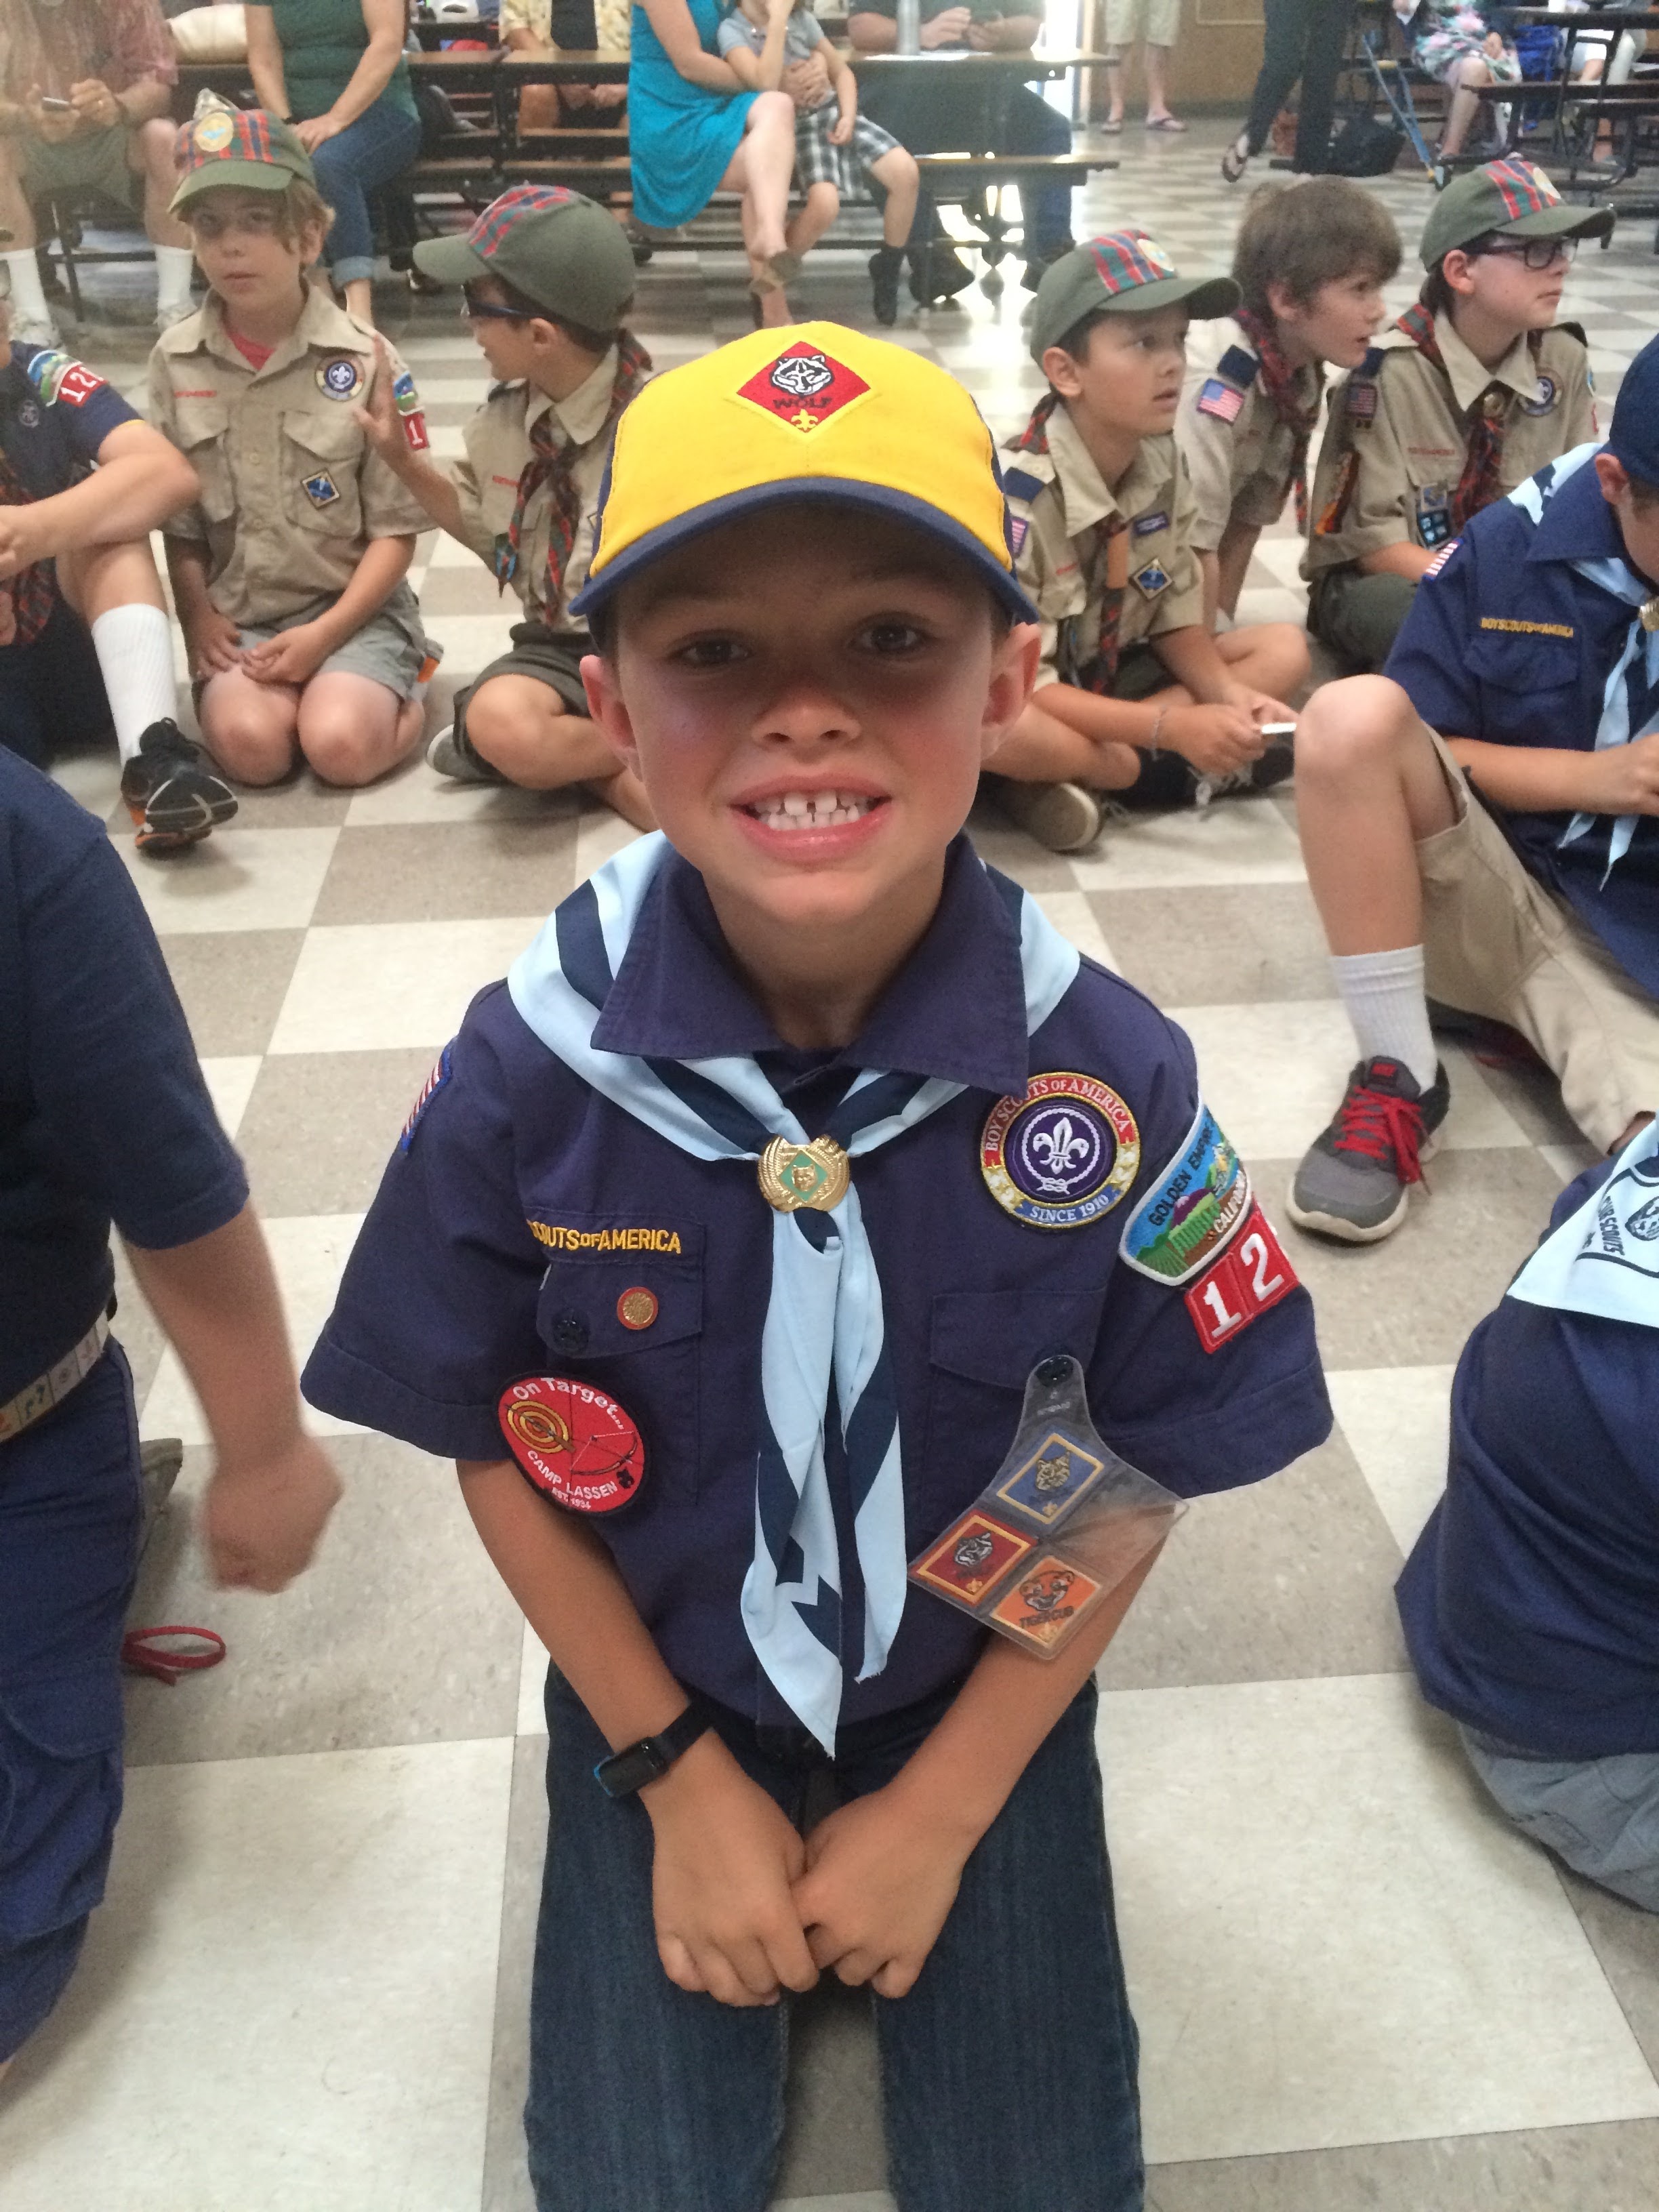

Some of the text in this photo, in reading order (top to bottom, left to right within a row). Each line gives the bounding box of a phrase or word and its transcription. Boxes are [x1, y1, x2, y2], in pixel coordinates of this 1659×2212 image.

[773, 397, 833, 409] WOLF
[985, 1120, 1004, 1151] BOY
[1067, 1079, 1130, 1132] AMERICA
[1030, 1194, 1109, 1222] SINCE 1910
[1148, 1169, 1192, 1226] GOLDEN
[513, 1382, 541, 1400] On
[527, 1450, 618, 1500] CAMP LASSEN
